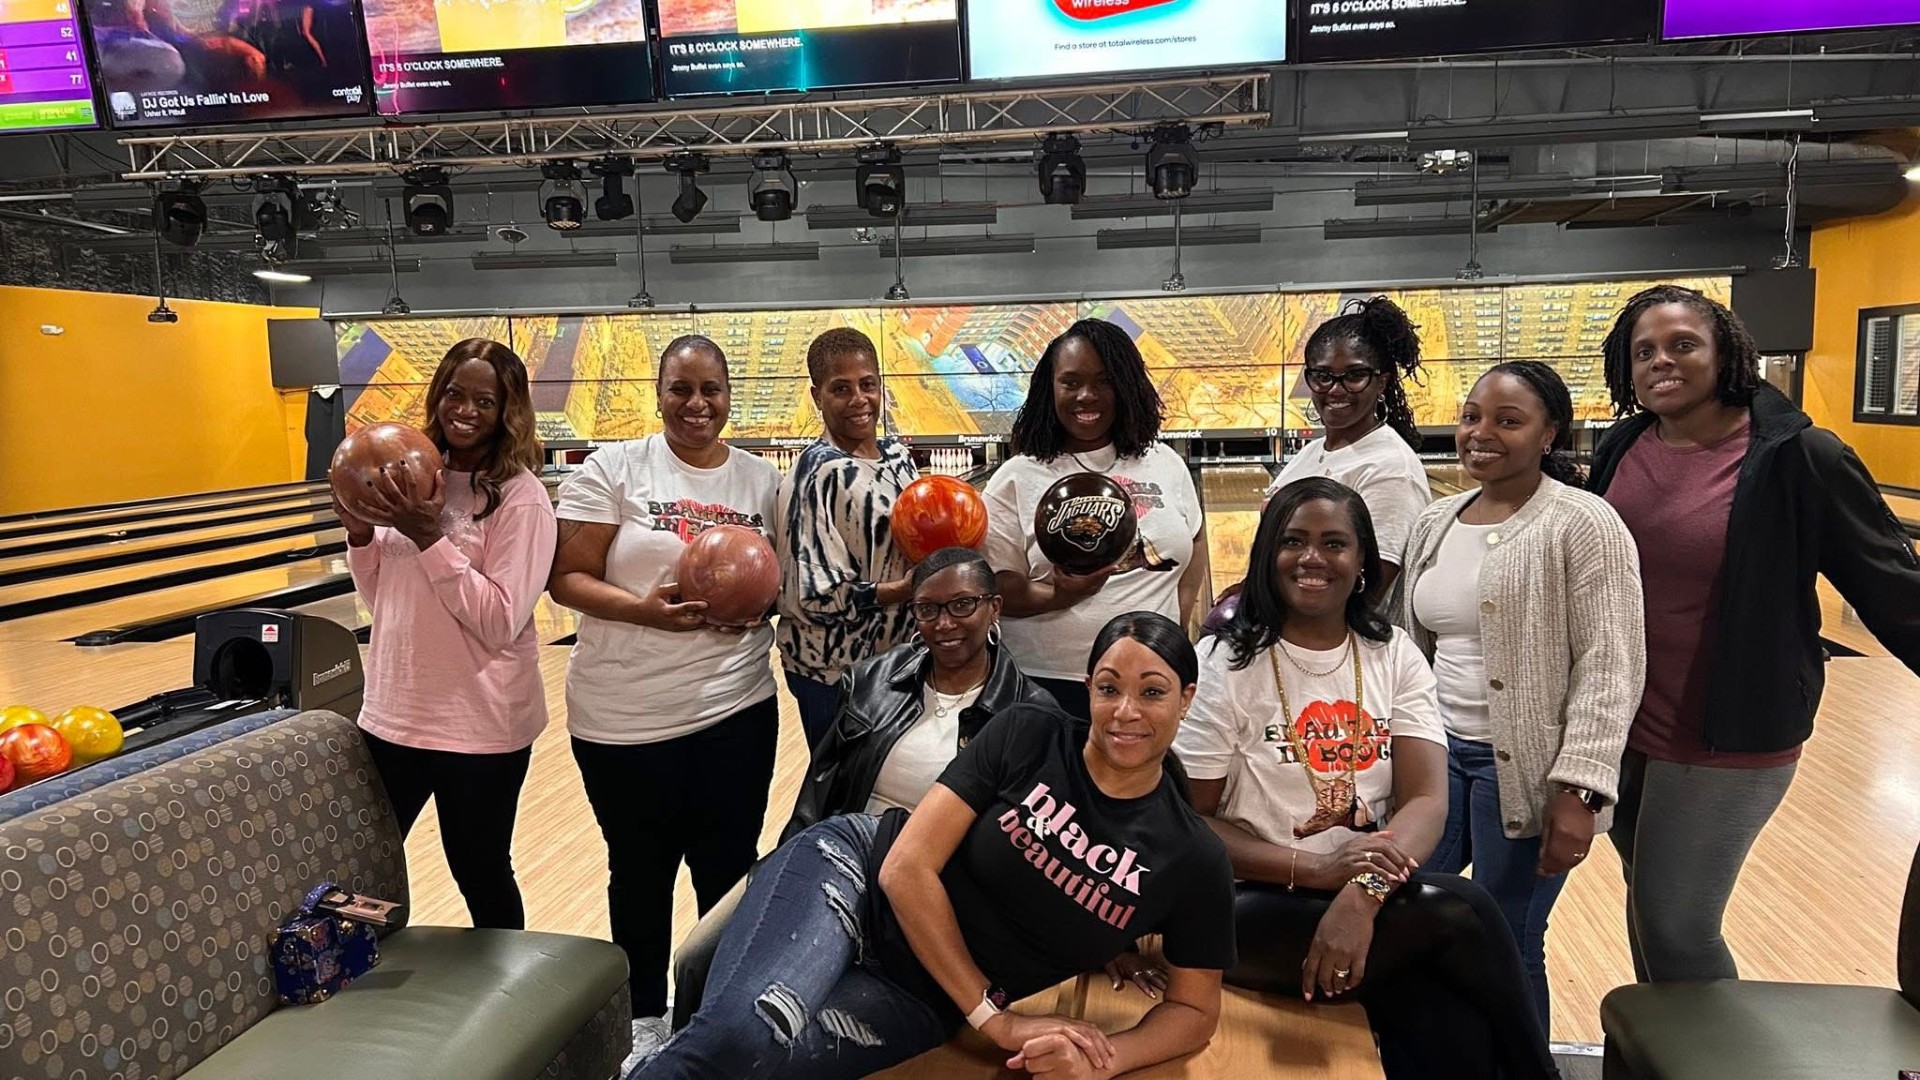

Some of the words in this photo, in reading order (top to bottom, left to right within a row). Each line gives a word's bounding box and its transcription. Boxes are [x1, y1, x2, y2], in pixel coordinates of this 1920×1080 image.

[1311, 3, 1330, 15] IT'S
[1340, 0, 1390, 13] O'CLOCK
[61, 27, 73, 37] 52
[669, 44, 687, 55] IT'S
[696, 41, 739, 53] O'CLOCK
[739, 37, 803, 50] SOMEWHERE.
[1108, 35, 1197, 47] totalwireless.com/stores
[65, 50, 77, 61] 41
[378, 62, 395, 72] IT'S
[403, 60, 444, 71] O'CLOCK
[444, 57, 505, 69] SOMEWHERE.
[69, 74, 82, 85] 77
[142, 97, 157, 109] DJ
[159, 96, 180, 108] Got
[180, 95, 195, 107] Us
[196, 92, 228, 106] Fallin'
[230, 94, 242, 104] In
[243, 92, 269, 103] Love
[958, 433, 1003, 443] Brunswick
[1265, 427, 1278, 436] 10
[1287, 429, 1298, 437] 11
[1049, 500, 1123, 532] JAGUARS
[1026, 814, 1052, 841] &
[1021, 782, 1151, 896] black
[997, 808, 1137, 930] beautiful
